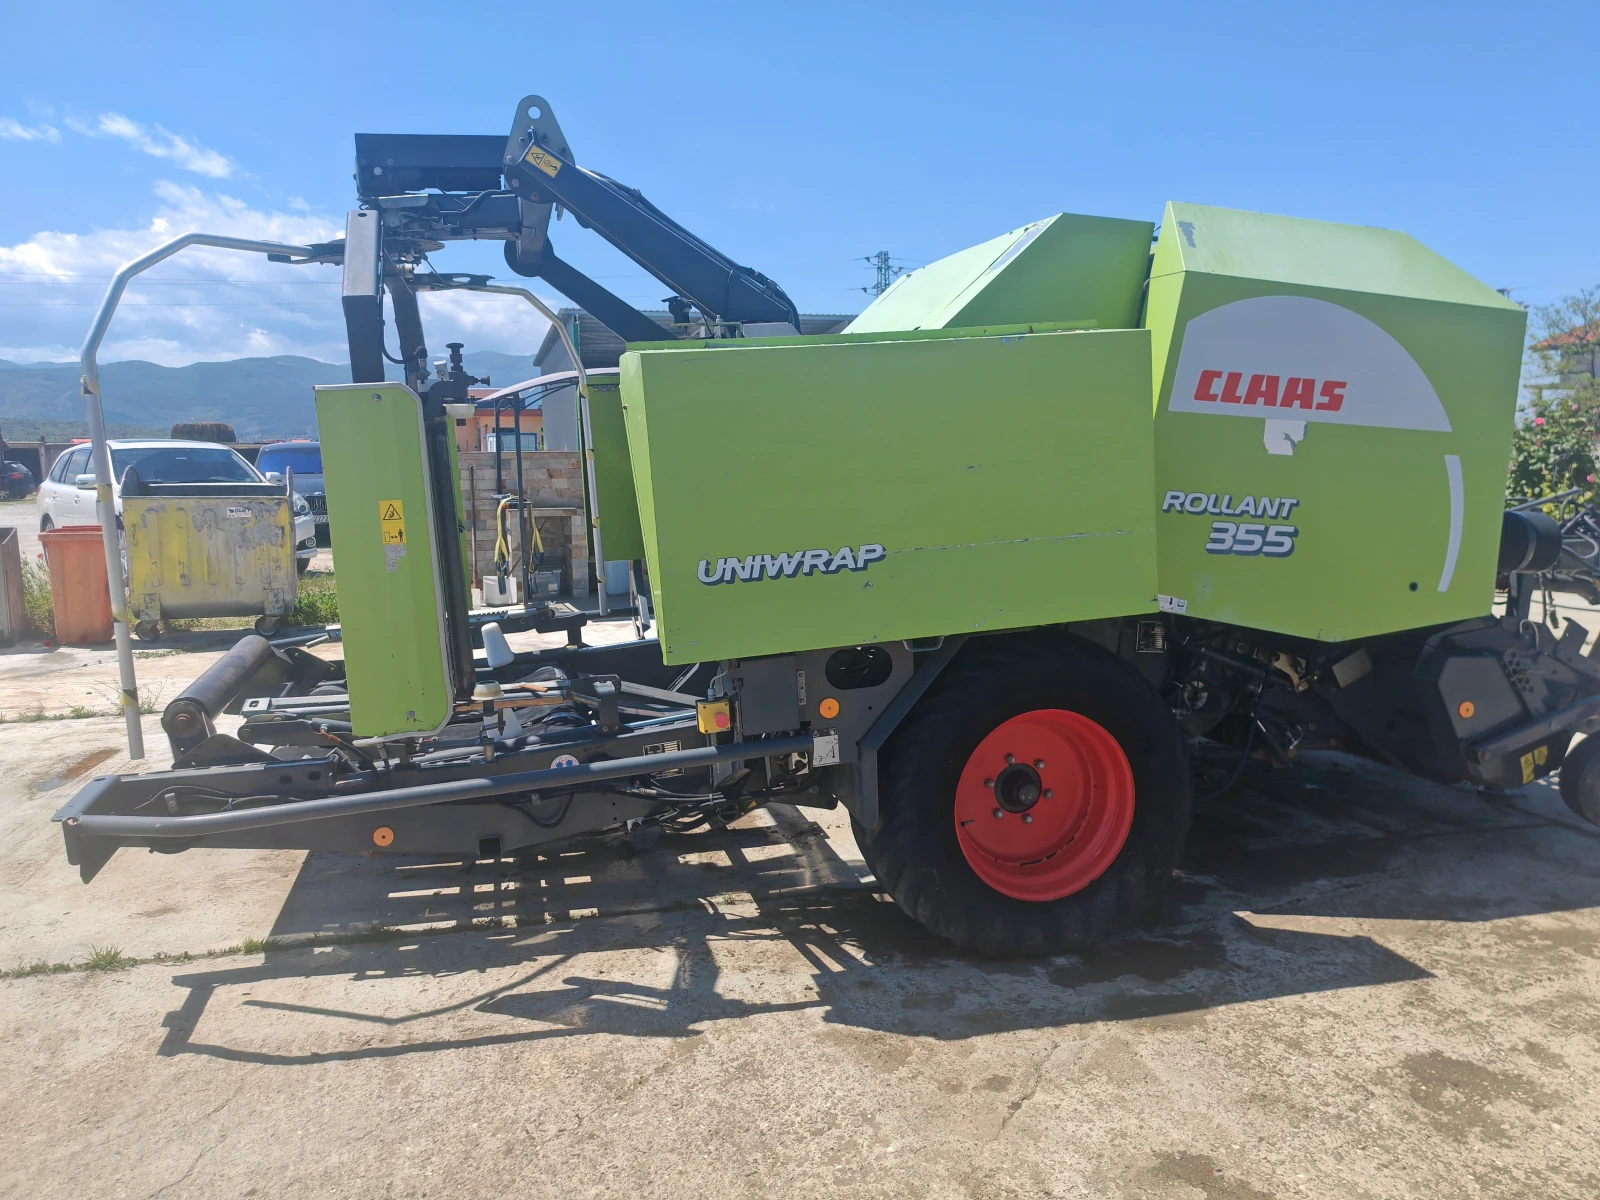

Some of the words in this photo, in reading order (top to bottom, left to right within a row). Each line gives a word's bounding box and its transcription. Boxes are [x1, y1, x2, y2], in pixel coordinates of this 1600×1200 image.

[1193, 369, 1348, 412] CLAAS
[1161, 490, 1300, 520] ROLLANT
[1204, 521, 1300, 558] 355
[697, 543, 887, 587] UNIWRAP
